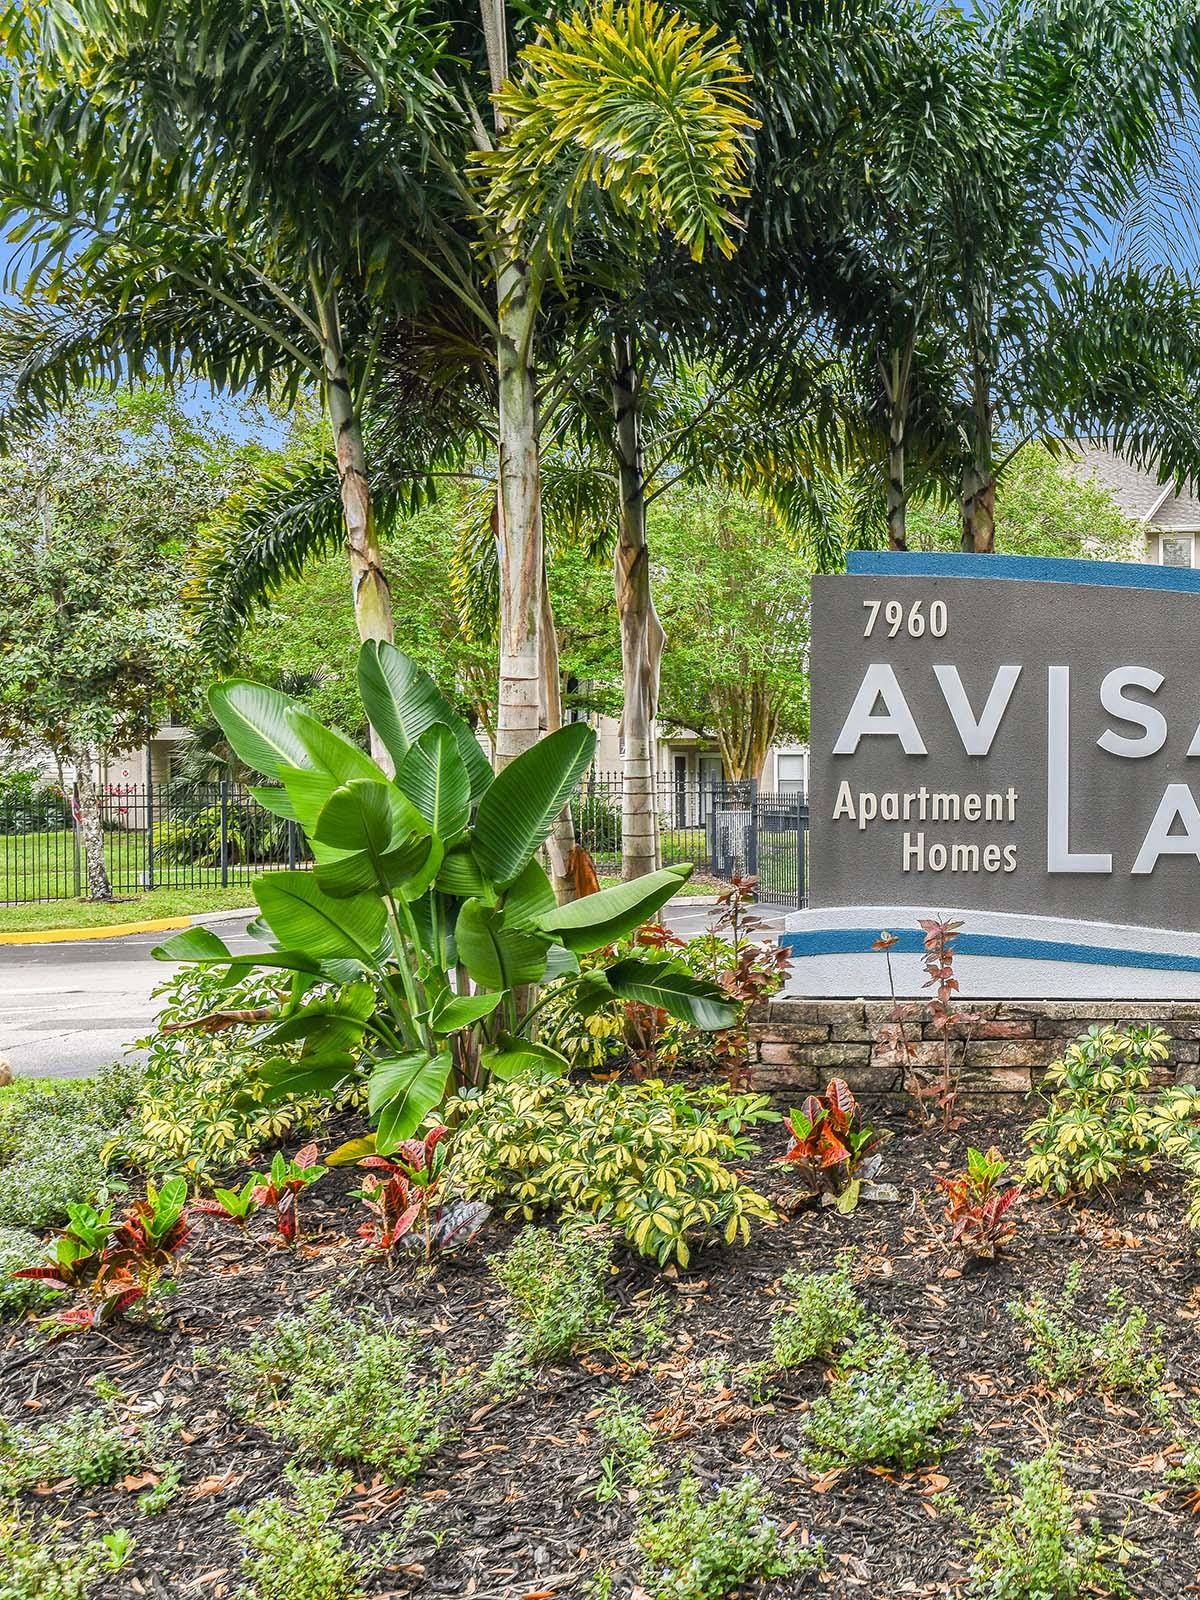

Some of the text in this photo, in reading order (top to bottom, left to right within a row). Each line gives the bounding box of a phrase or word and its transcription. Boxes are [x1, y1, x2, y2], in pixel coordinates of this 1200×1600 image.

[863, 600, 948, 638] 7960
[832, 781, 1018, 829] Apartment
[903, 832, 1017, 873] Homes
